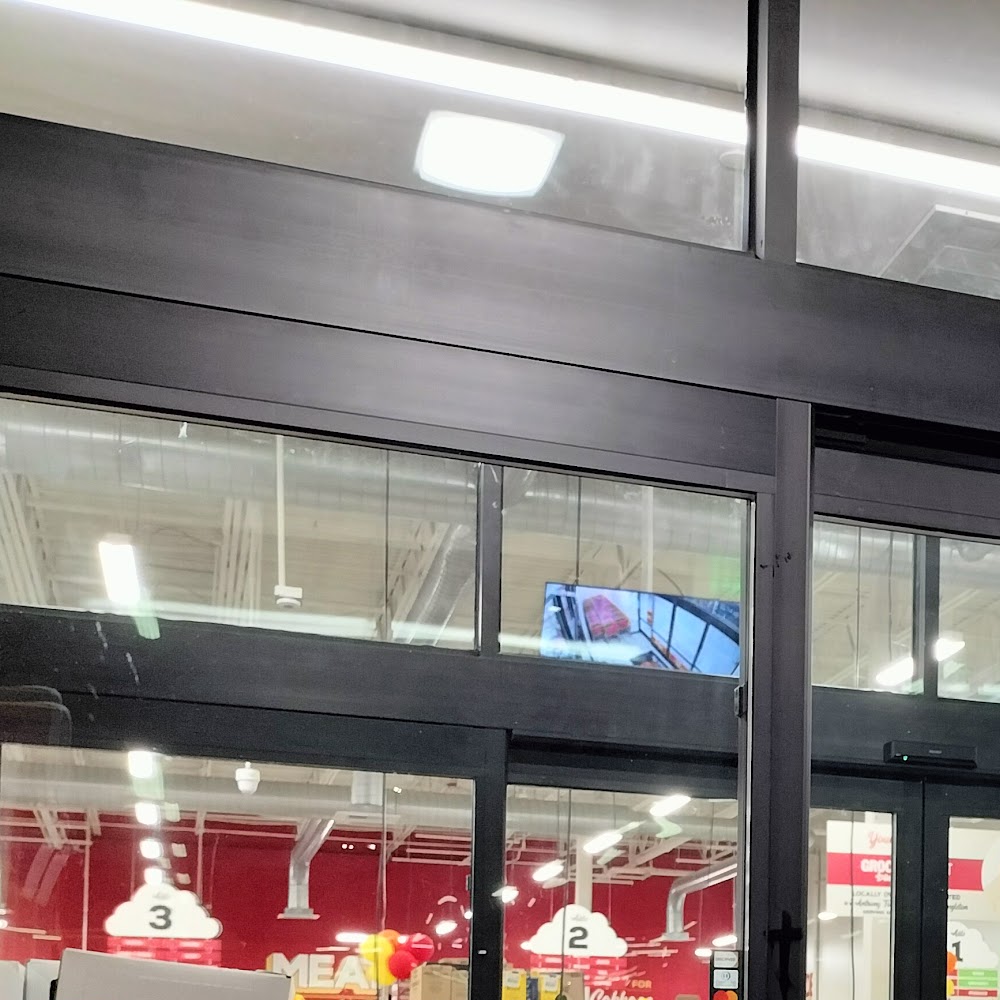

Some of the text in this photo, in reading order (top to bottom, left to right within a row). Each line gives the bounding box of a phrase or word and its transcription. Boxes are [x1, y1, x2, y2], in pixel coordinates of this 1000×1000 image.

[149, 905, 172, 930] 3
[568, 926, 588, 949] 2
[267, 953, 371, 988] MEA
[631, 980, 652, 989] FOR
